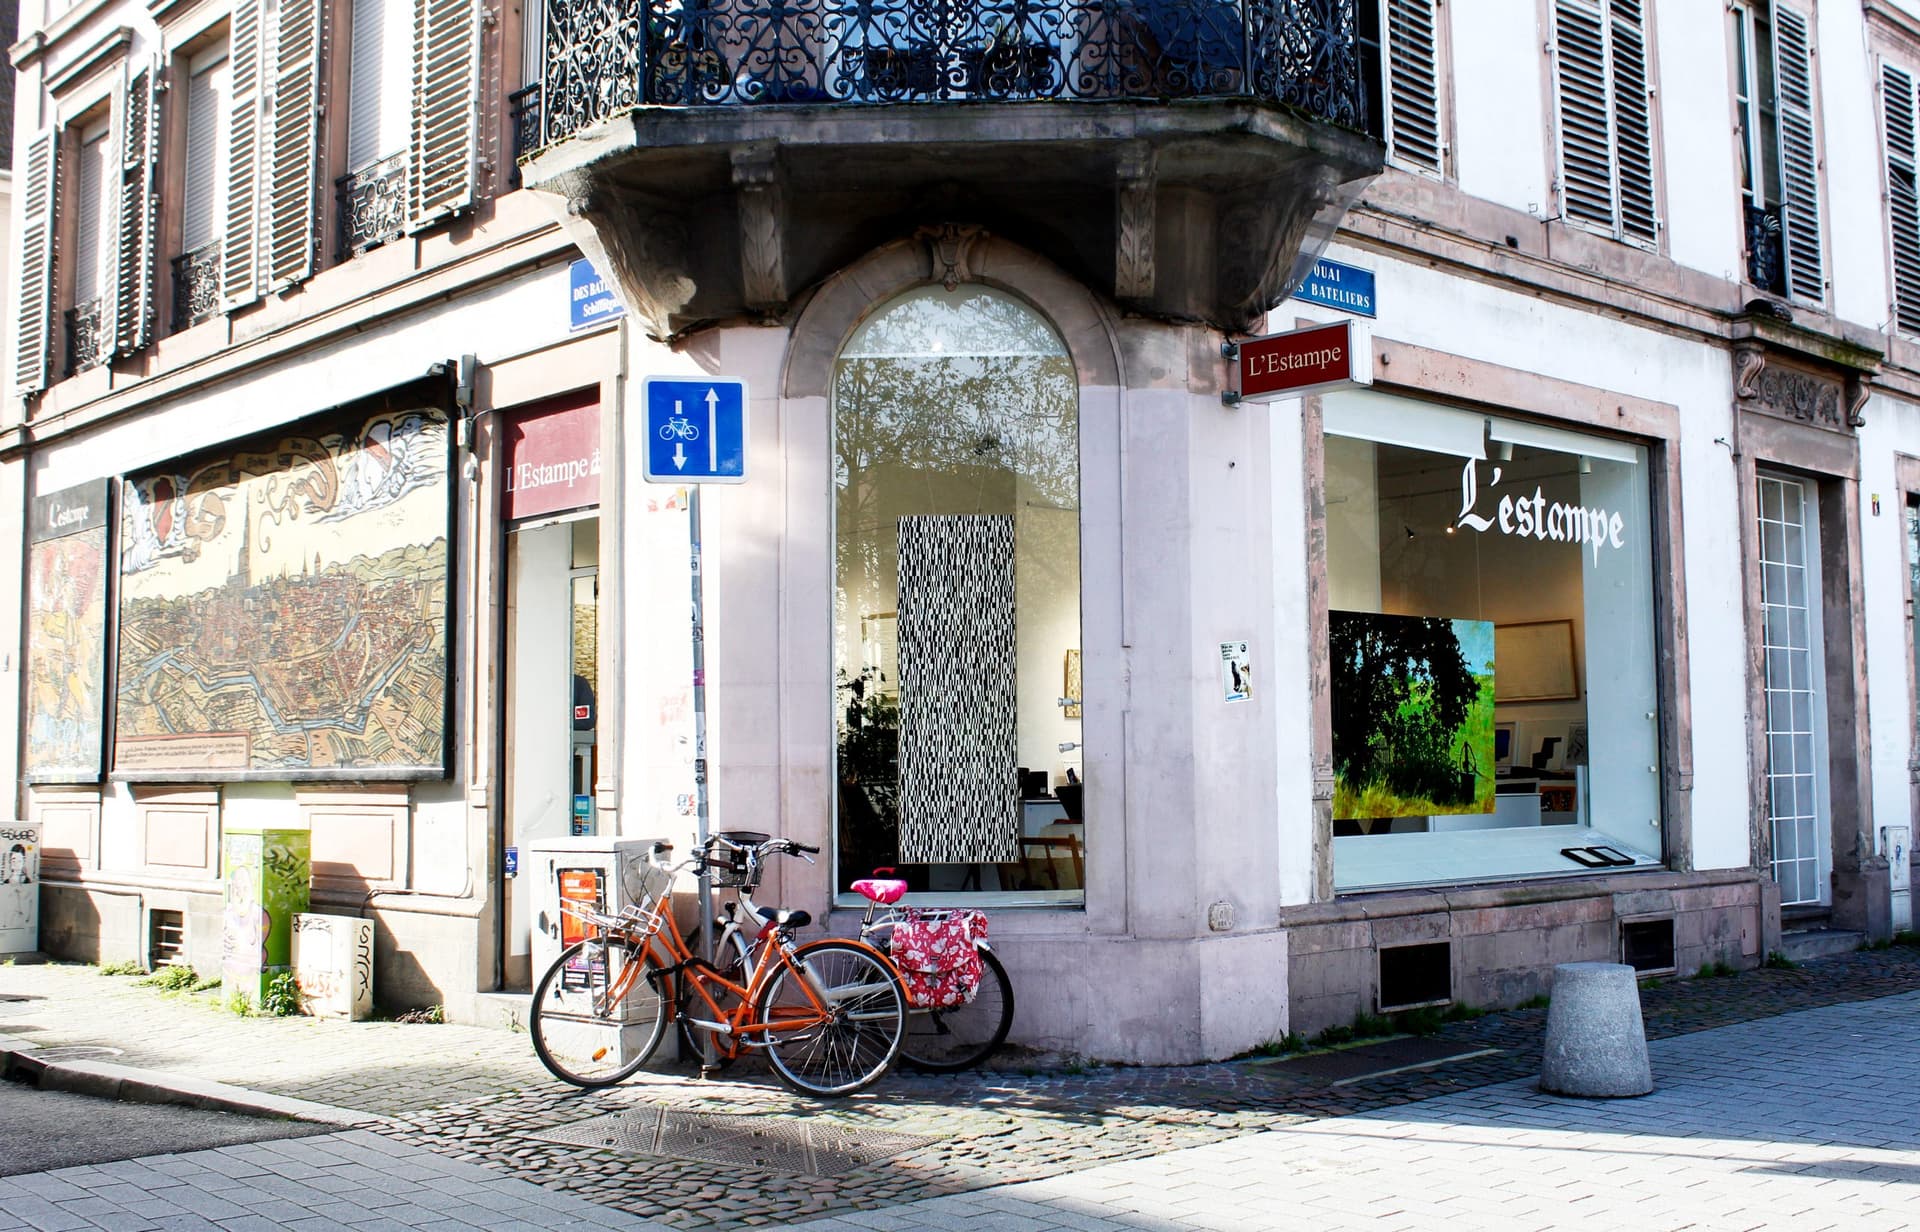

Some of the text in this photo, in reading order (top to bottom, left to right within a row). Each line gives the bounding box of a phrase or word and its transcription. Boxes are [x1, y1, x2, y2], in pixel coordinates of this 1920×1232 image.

[1313, 265, 1341, 282] QUAI
[1311, 283, 1370, 308] BATELIERS
[1249, 346, 1341, 377] L’Estampe
[506, 458, 588, 492] L'Estampe
[1457, 457, 1624, 568] L’estampe
